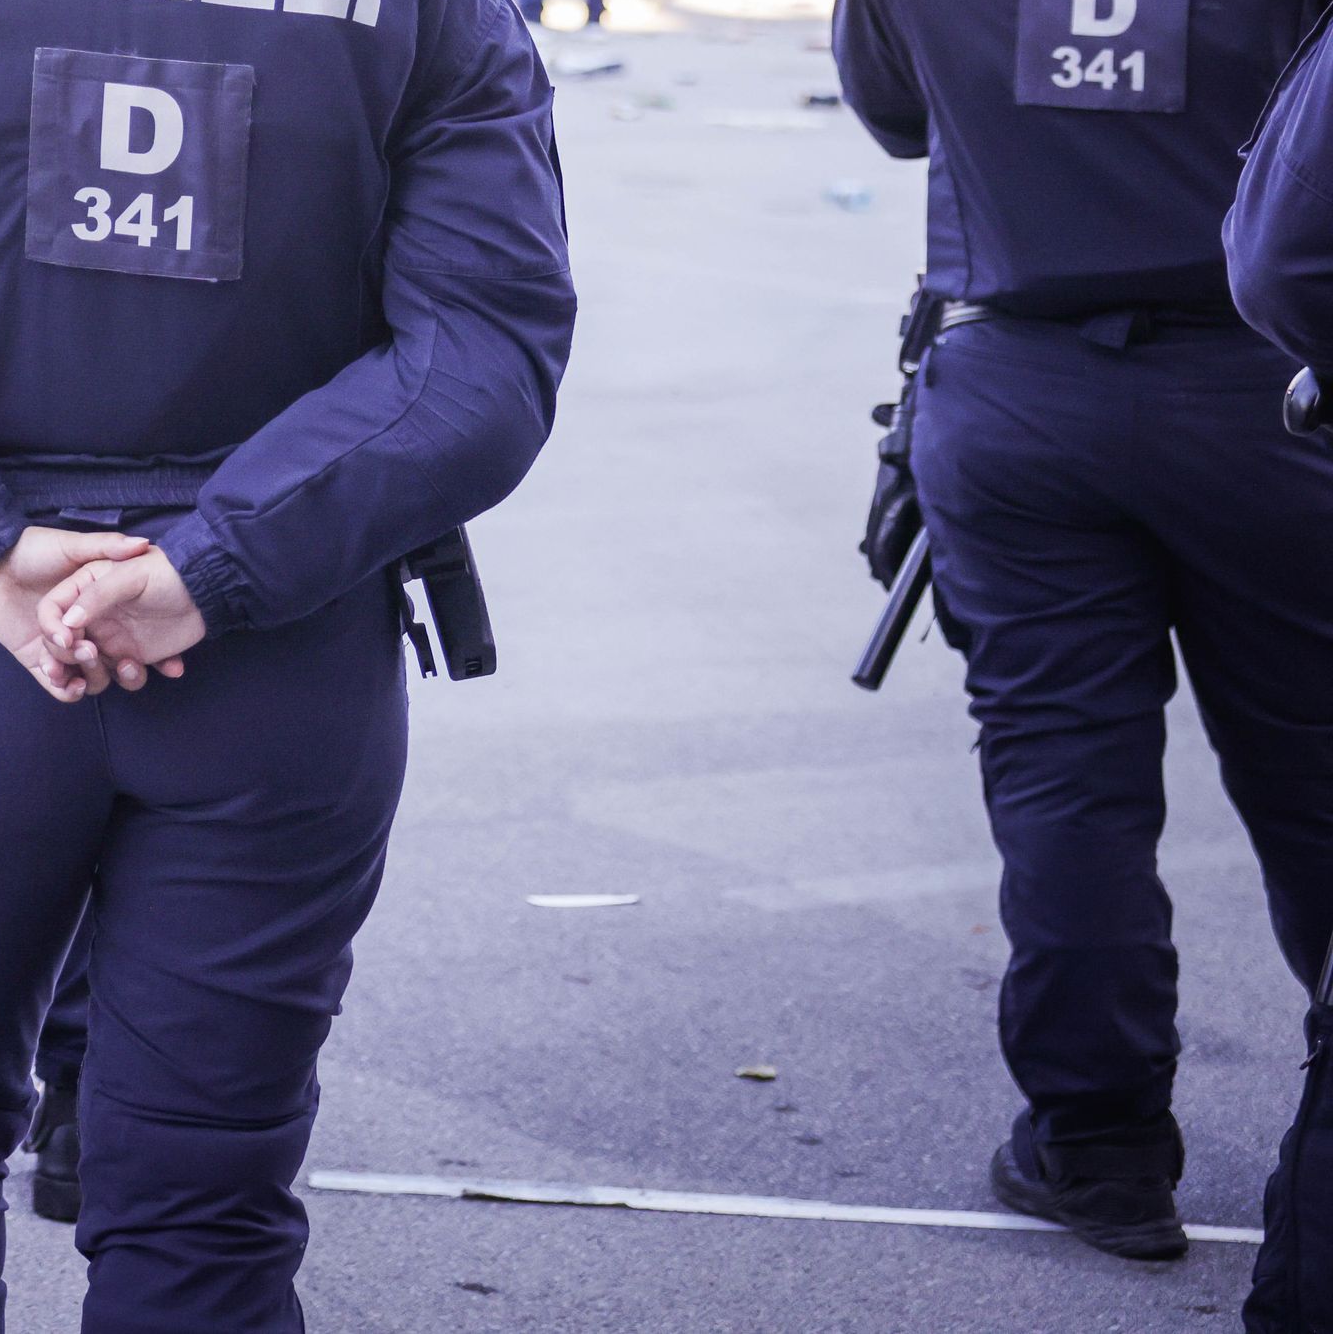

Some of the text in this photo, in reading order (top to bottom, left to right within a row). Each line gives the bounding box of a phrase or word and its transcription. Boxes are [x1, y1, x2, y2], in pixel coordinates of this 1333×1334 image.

[1051, 46, 1145, 92] 341
[100, 82, 184, 175] D
[71, 186, 194, 251] 341
